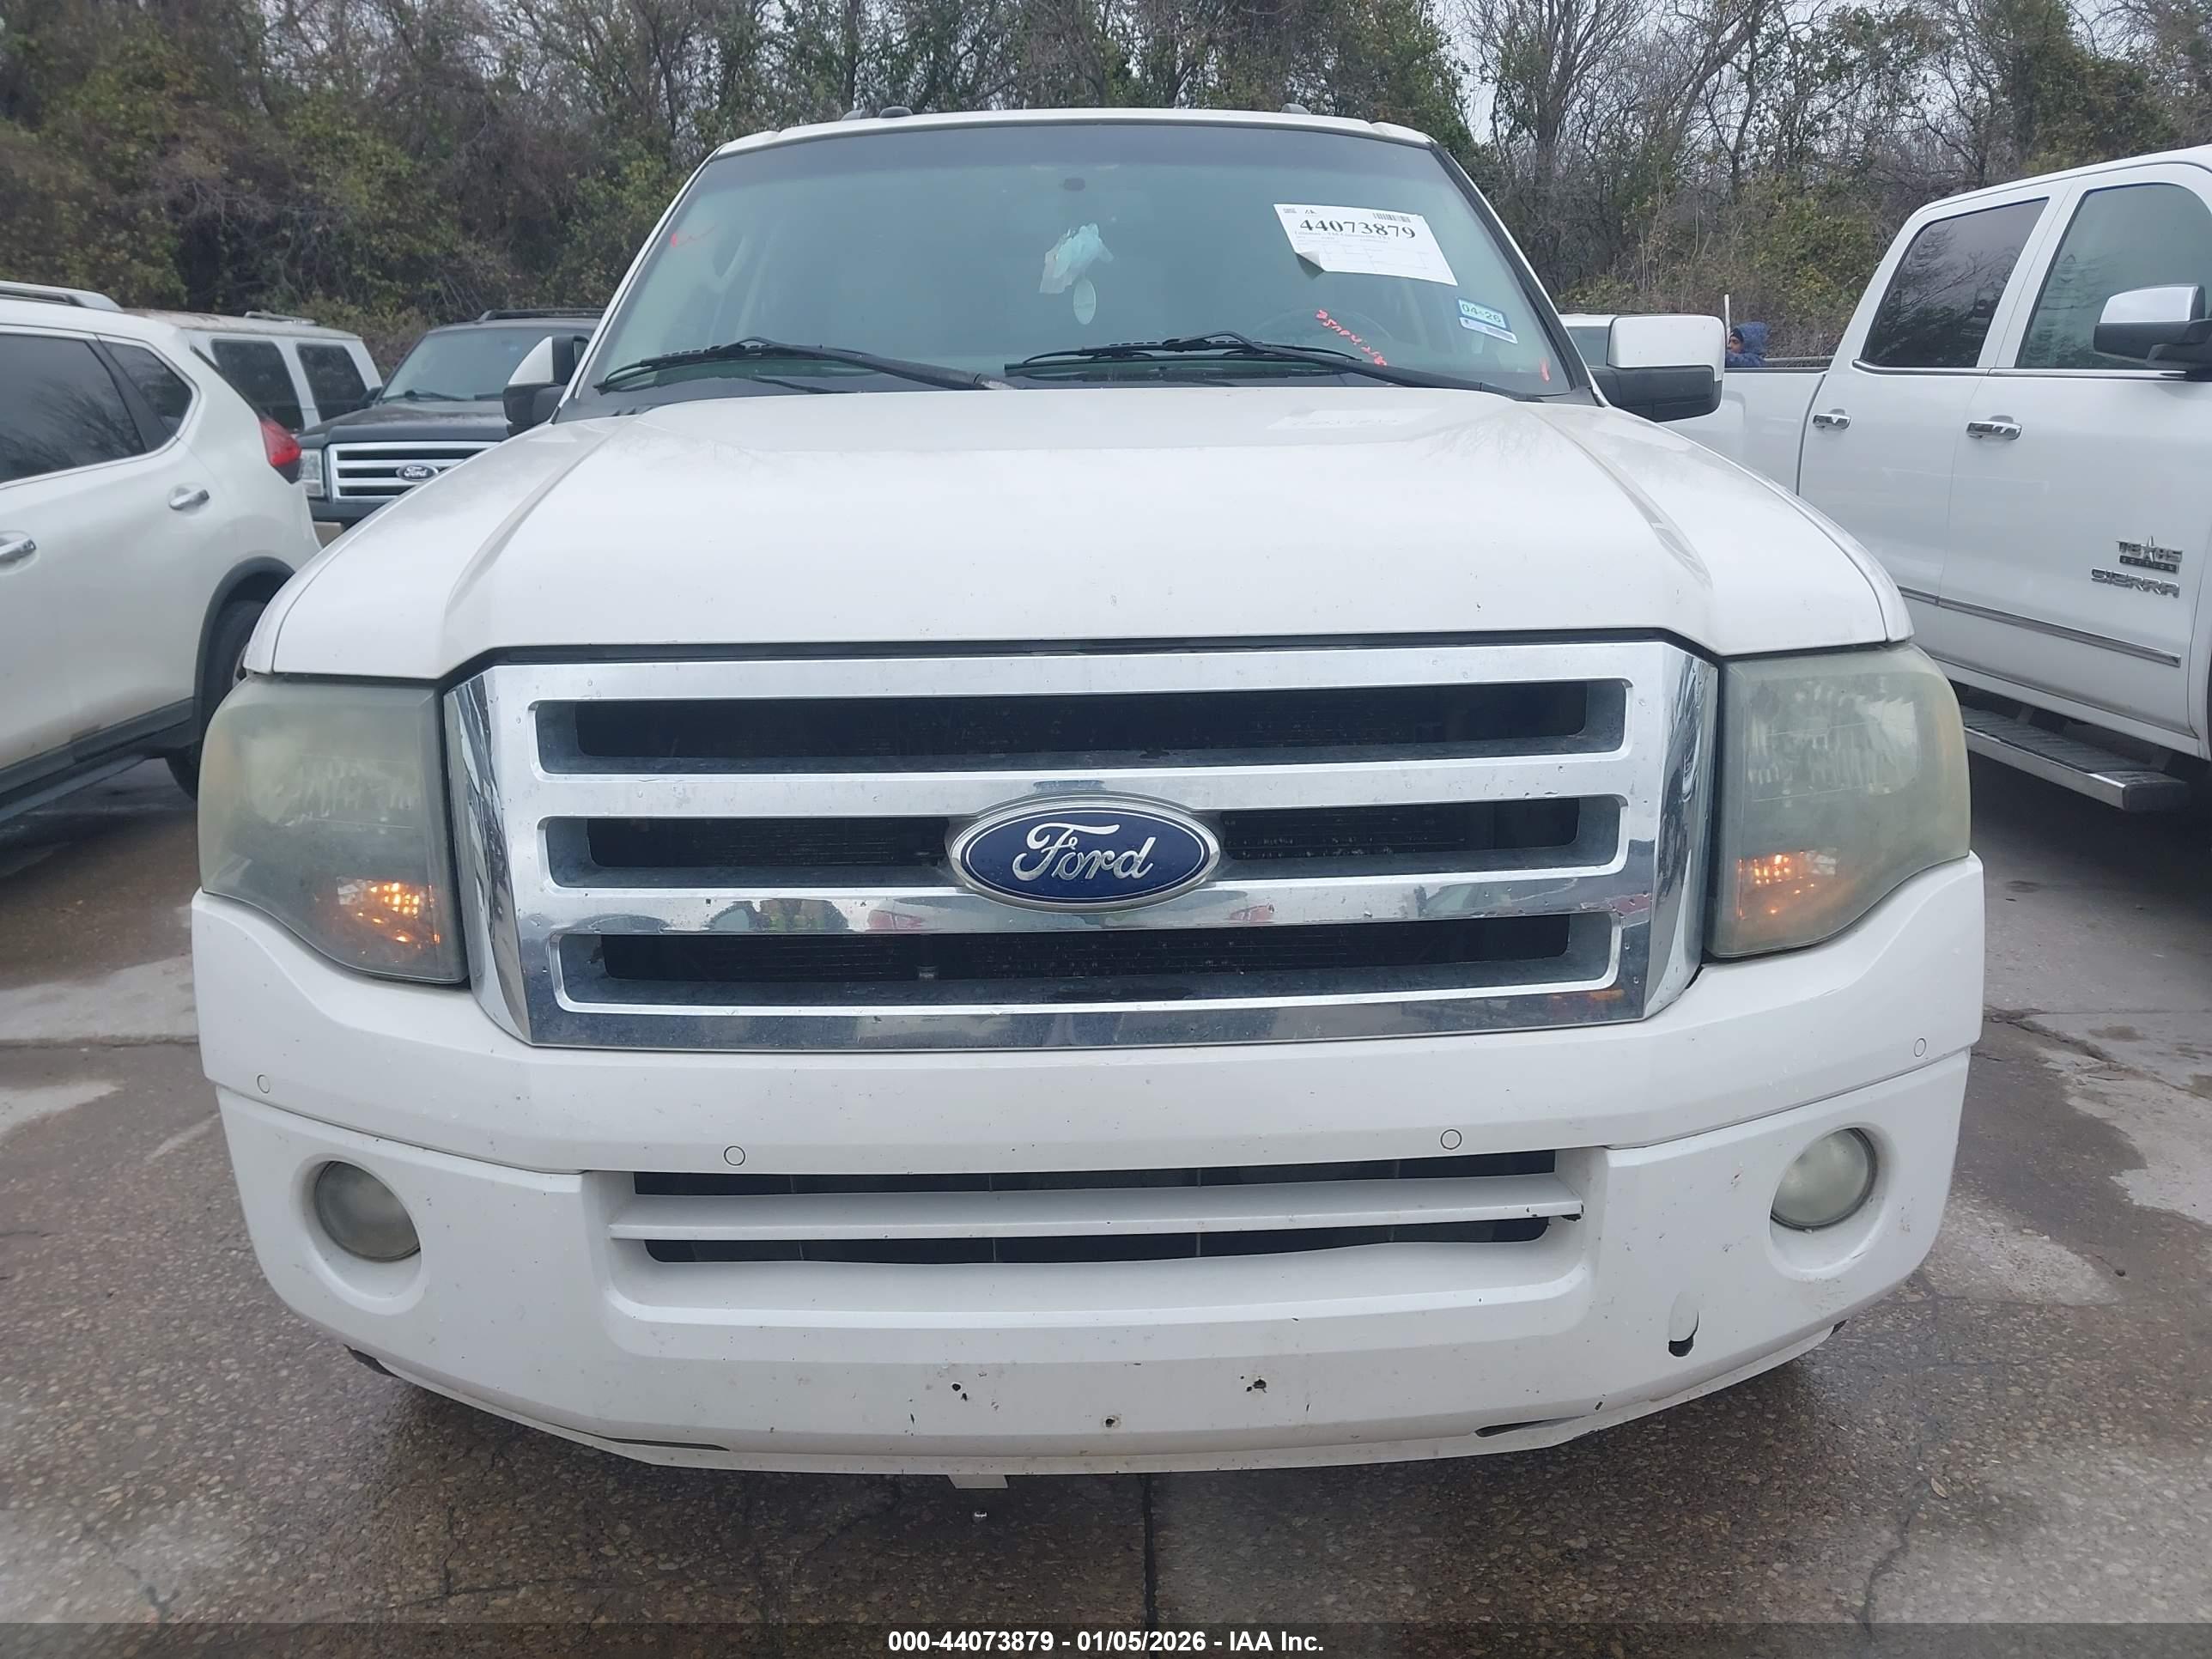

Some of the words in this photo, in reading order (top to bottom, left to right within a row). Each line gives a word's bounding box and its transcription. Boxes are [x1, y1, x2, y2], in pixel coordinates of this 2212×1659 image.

[1299, 219, 1416, 239] 44073879
[1462, 303, 1502, 323] 04-26
[404, 465, 428, 477] Ford
[2091, 568, 2179, 599] SIERRA
[1012, 822, 1157, 882] Ford
